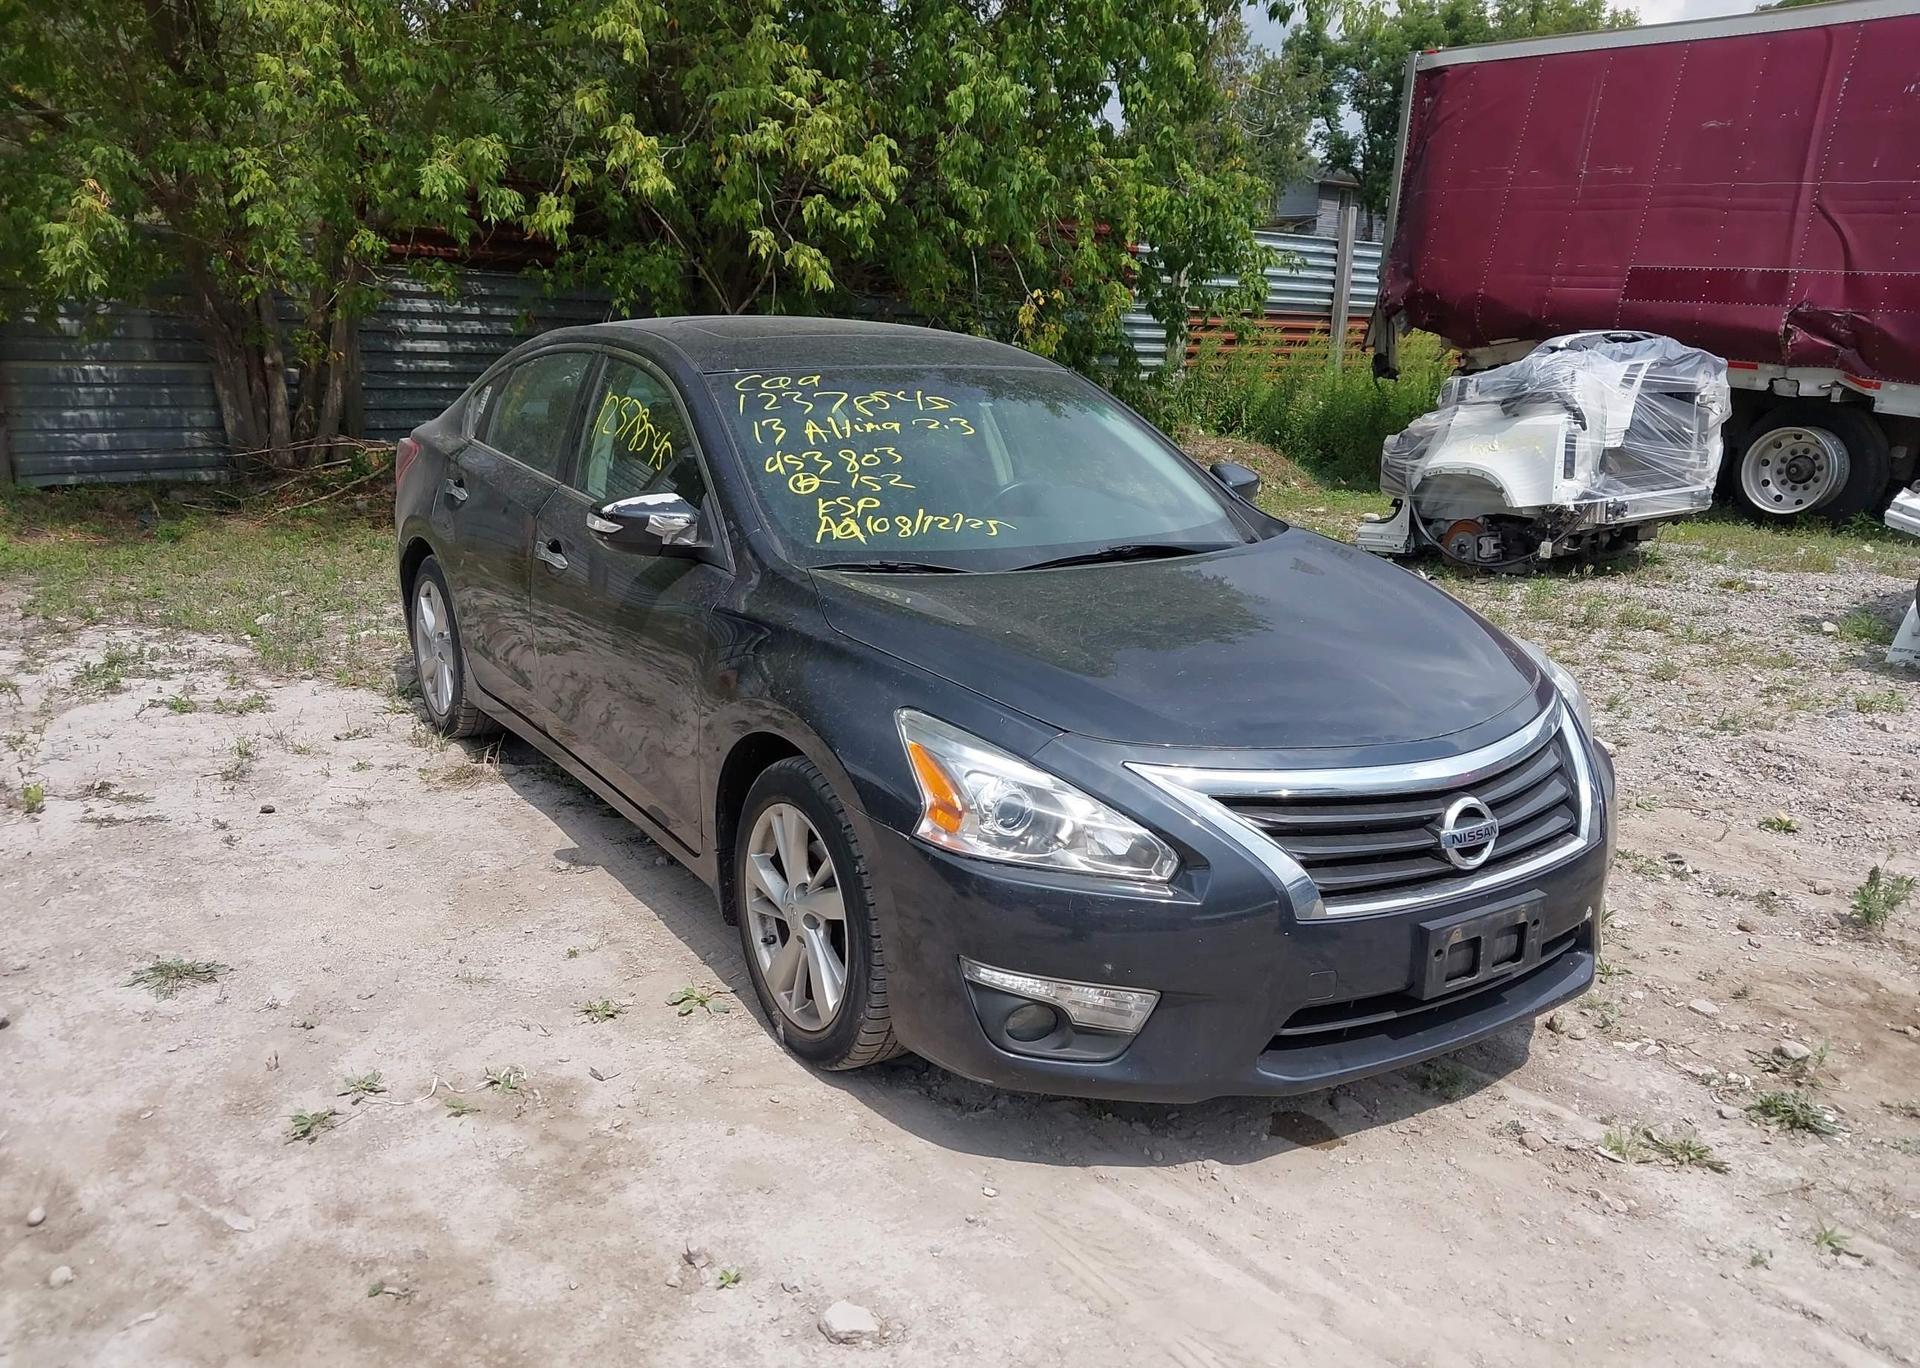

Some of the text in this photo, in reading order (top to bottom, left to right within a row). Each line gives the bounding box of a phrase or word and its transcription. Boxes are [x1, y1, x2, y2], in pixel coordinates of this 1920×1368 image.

[754, 418, 786, 445] 13
[804, 415, 901, 445] Altima
[1452, 825, 1497, 844] NISSAN
